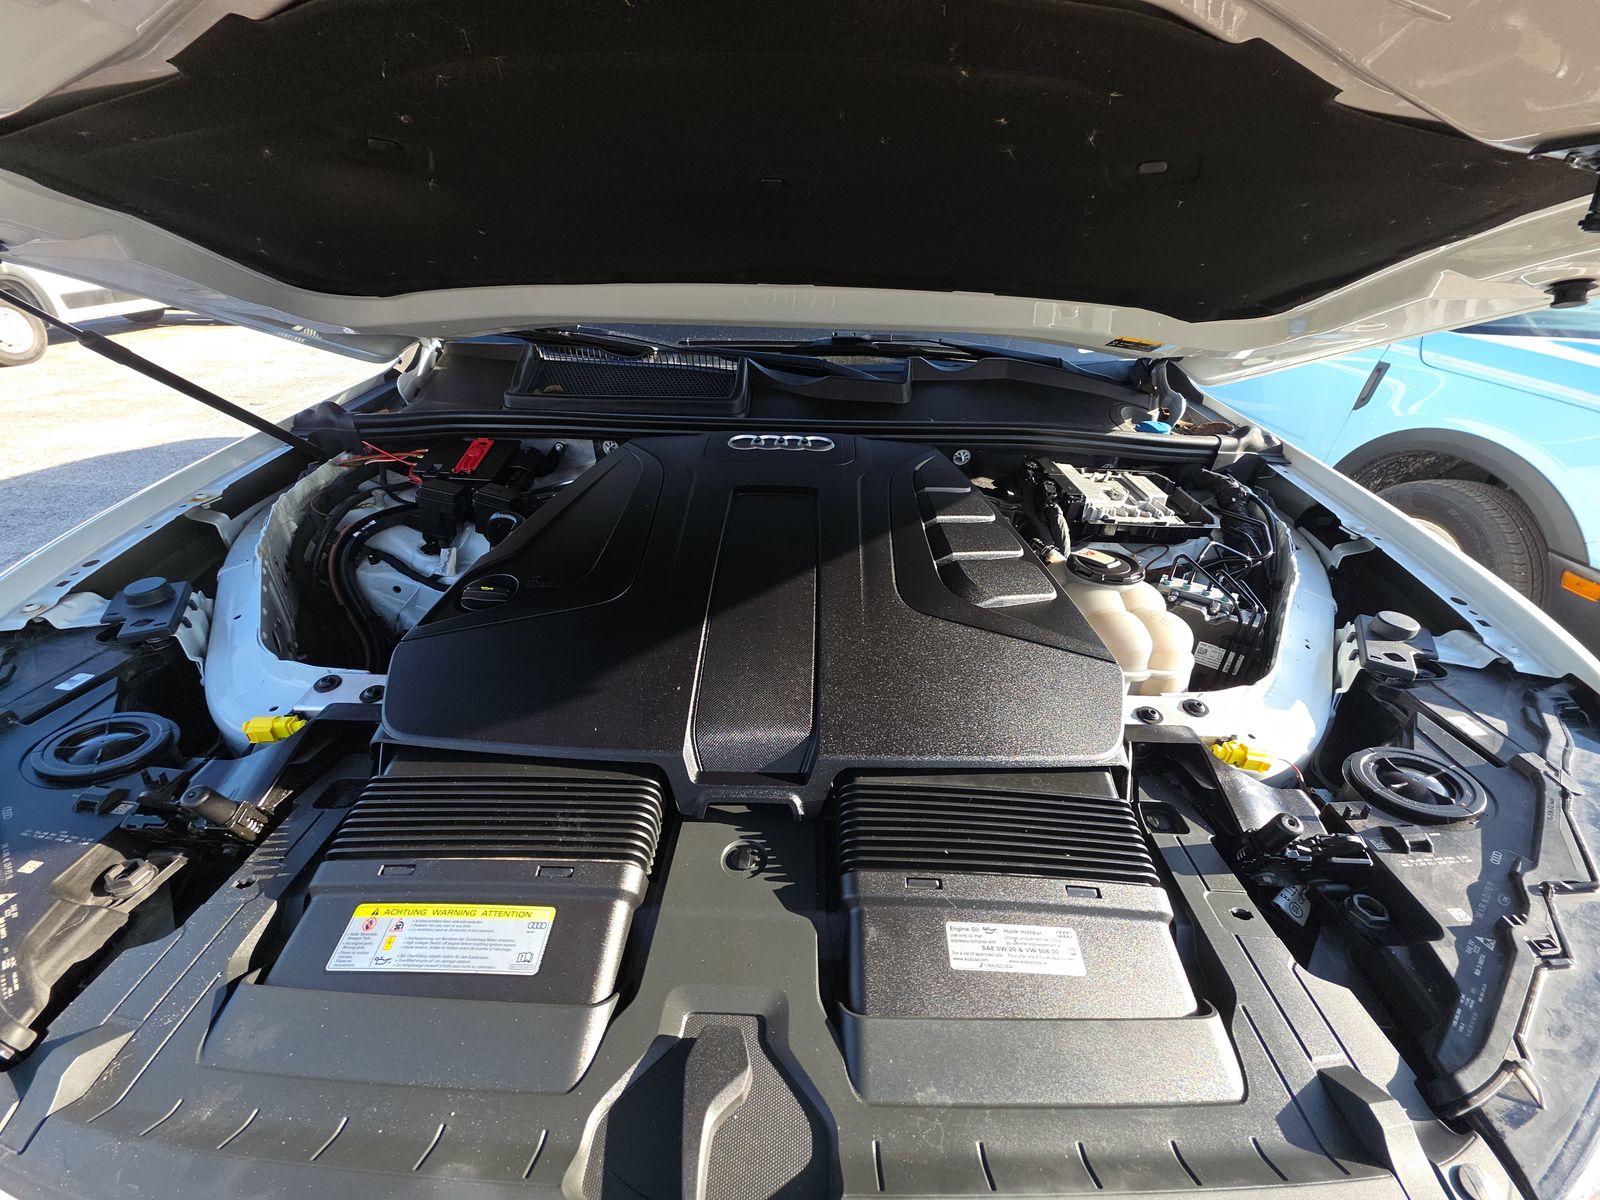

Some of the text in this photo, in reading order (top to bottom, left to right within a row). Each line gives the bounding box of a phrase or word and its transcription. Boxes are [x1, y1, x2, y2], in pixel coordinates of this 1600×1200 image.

[384, 908, 533, 918] ACHTUNG WARNING ATTENTION
